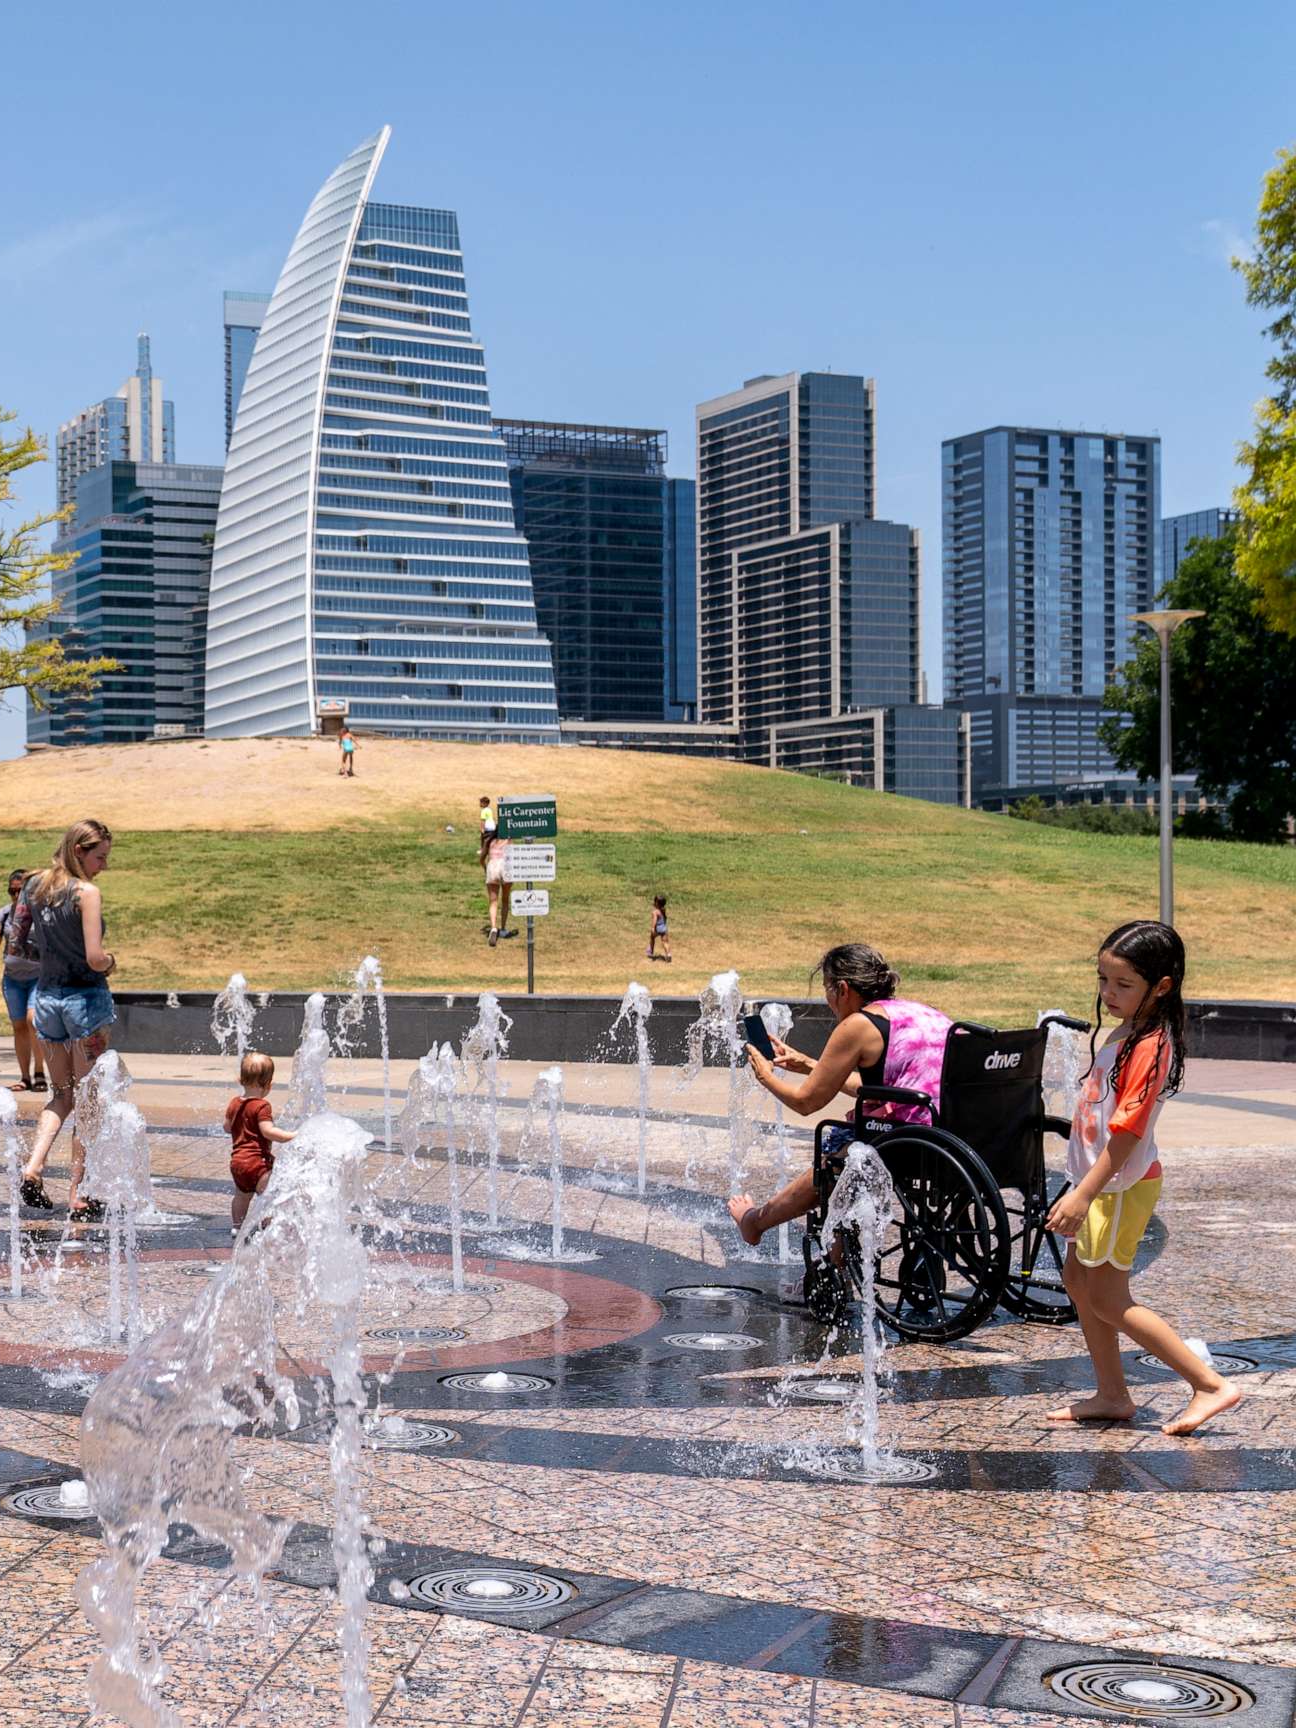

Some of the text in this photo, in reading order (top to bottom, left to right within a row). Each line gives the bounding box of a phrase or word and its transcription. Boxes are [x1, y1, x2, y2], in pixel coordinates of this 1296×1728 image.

[498, 806, 555, 817] Liz Carpenter
[507, 818, 548, 829] Fountain
[984, 1050, 1022, 1070] drive
[865, 1119, 893, 1132] drive
